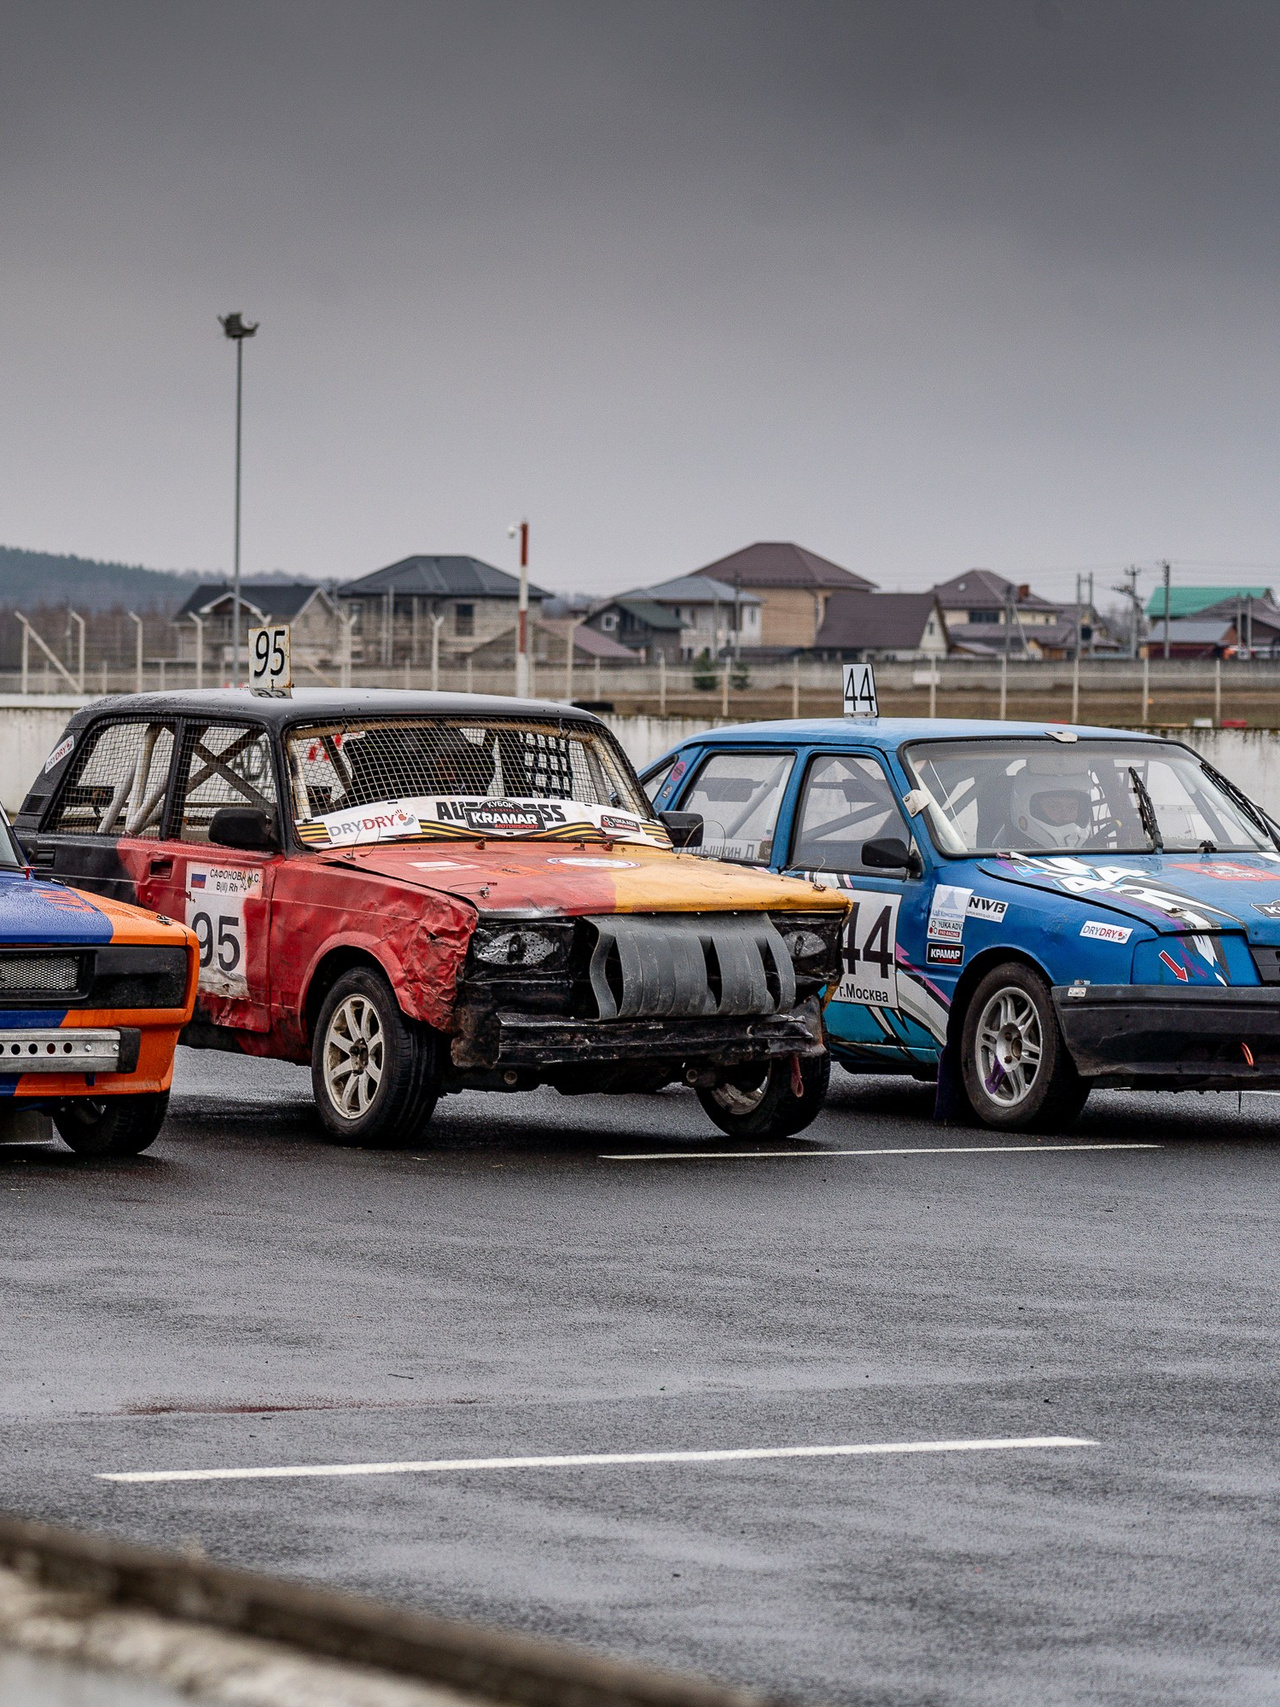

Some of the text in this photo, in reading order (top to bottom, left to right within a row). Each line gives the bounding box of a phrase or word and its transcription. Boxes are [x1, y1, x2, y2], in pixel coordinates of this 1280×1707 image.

[254, 630, 285, 677] 95
[845, 668, 874, 711] 44
[329, 814, 395, 838] DRYDRY
[470, 811, 538, 824] KRAMAR
[1054, 865, 1157, 893] 44
[968, 896, 1006, 913] NWB
[191, 911, 241, 972] 95
[841, 902, 894, 979] 44
[1082, 925, 1118, 939] DRYDRY
[930, 948, 960, 959] КРАМАР
[839, 982, 889, 1003] г.Москва
